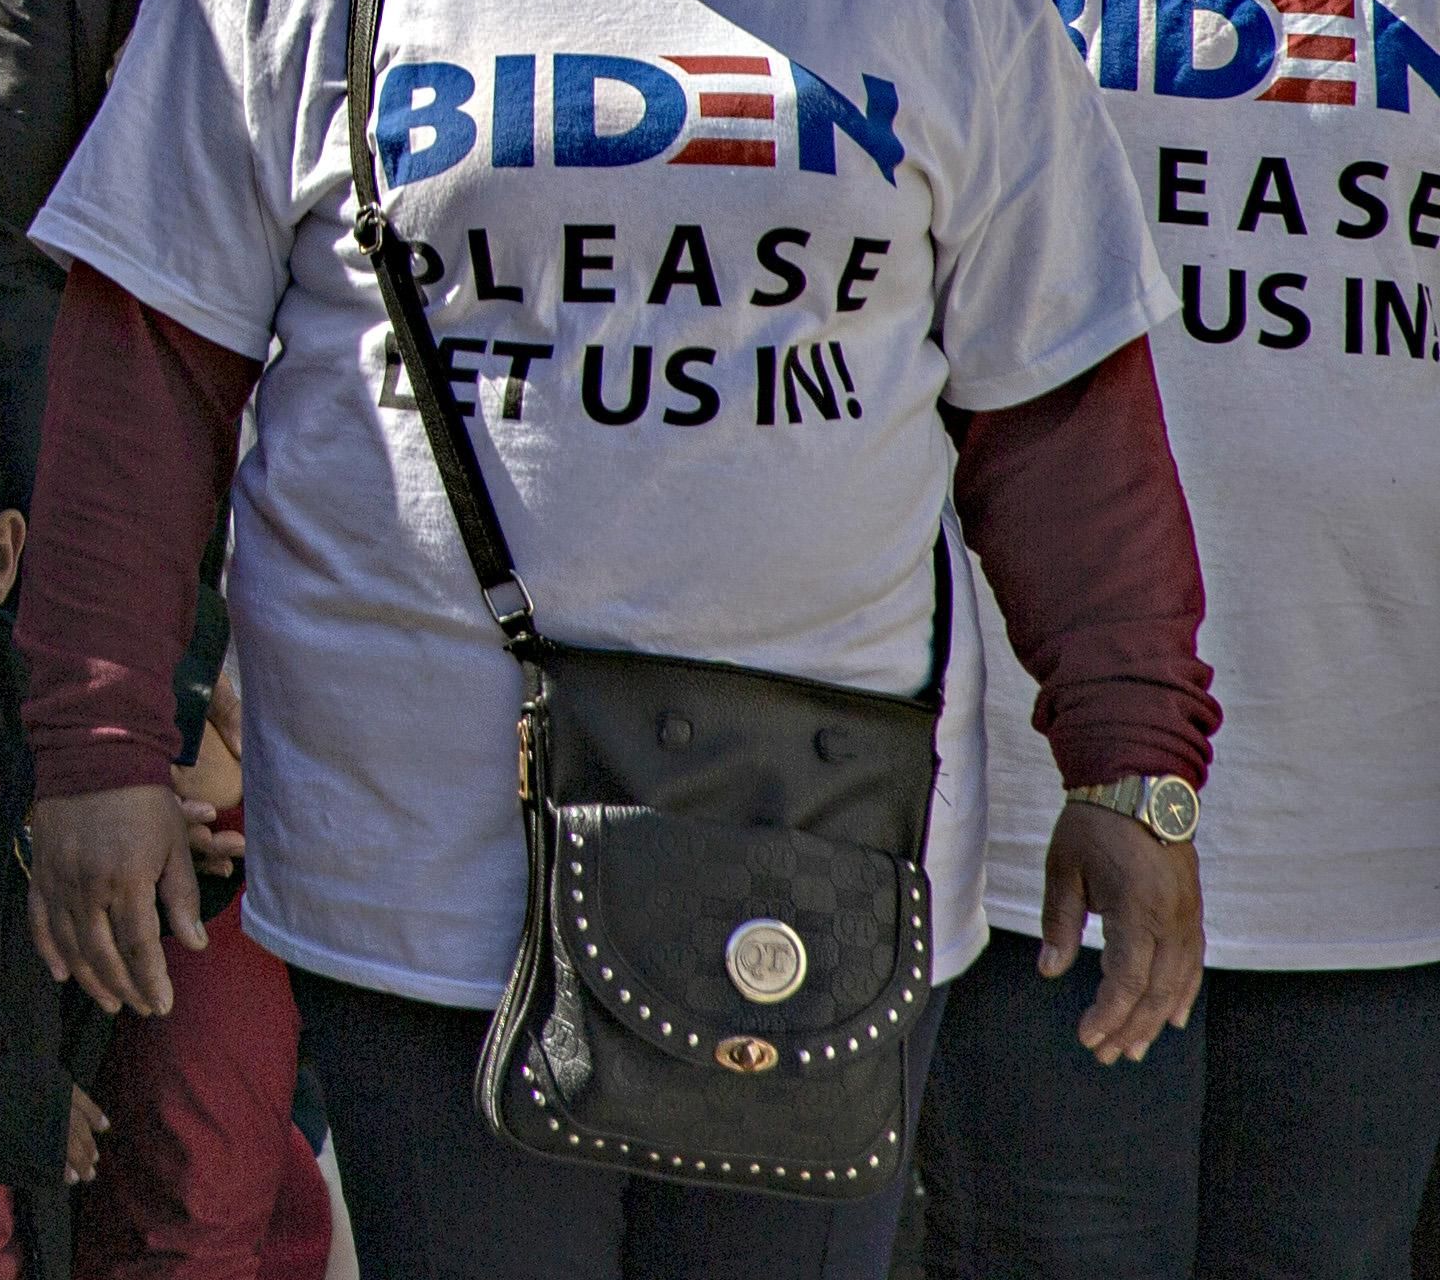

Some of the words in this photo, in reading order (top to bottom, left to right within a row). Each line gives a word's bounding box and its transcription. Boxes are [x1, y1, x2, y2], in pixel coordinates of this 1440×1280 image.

[374, 53, 905, 189] BIDEN
[1181, 264, 1312, 351] US
[581, 343, 721, 426] US
[755, 340, 864, 426] IN!
